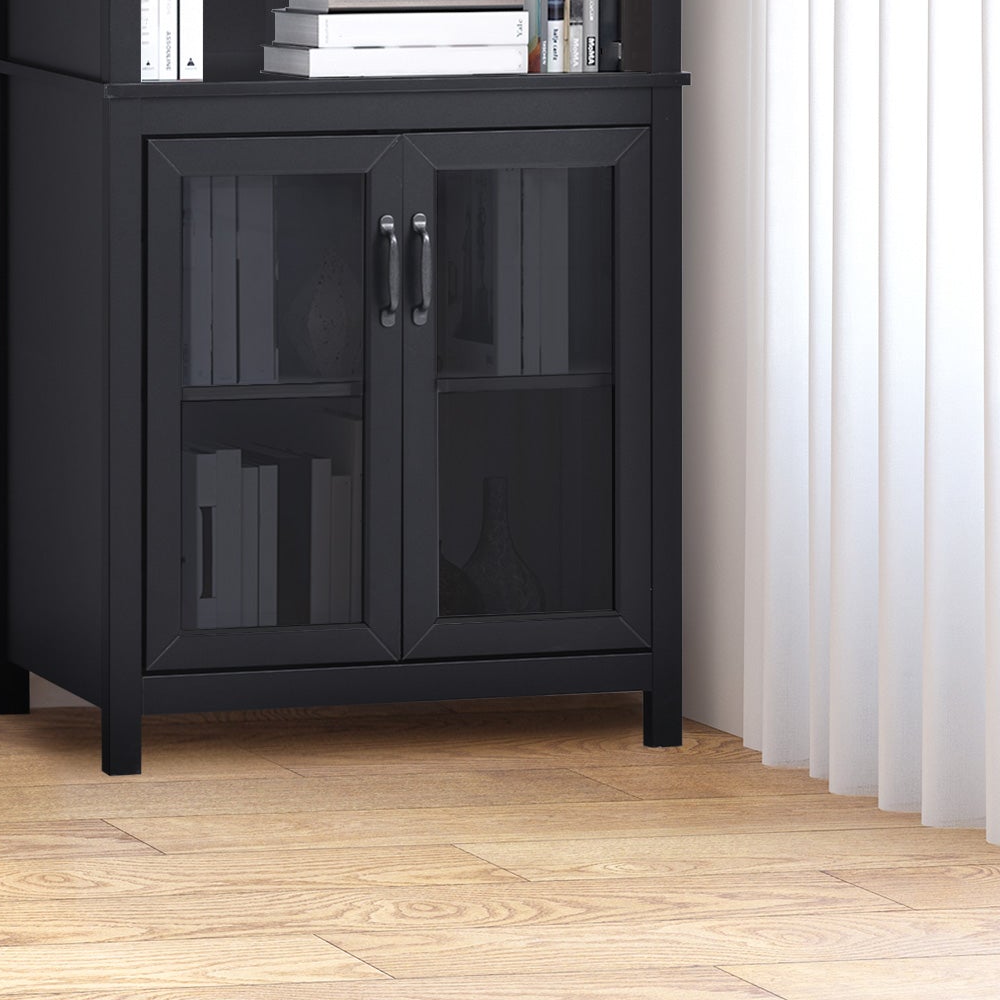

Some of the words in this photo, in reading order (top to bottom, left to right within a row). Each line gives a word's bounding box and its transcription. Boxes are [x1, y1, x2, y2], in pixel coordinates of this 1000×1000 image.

[516, 19, 524, 39] Yale
[572, 38, 580, 67] MoMA
[588, 37, 596, 65] MoMA
